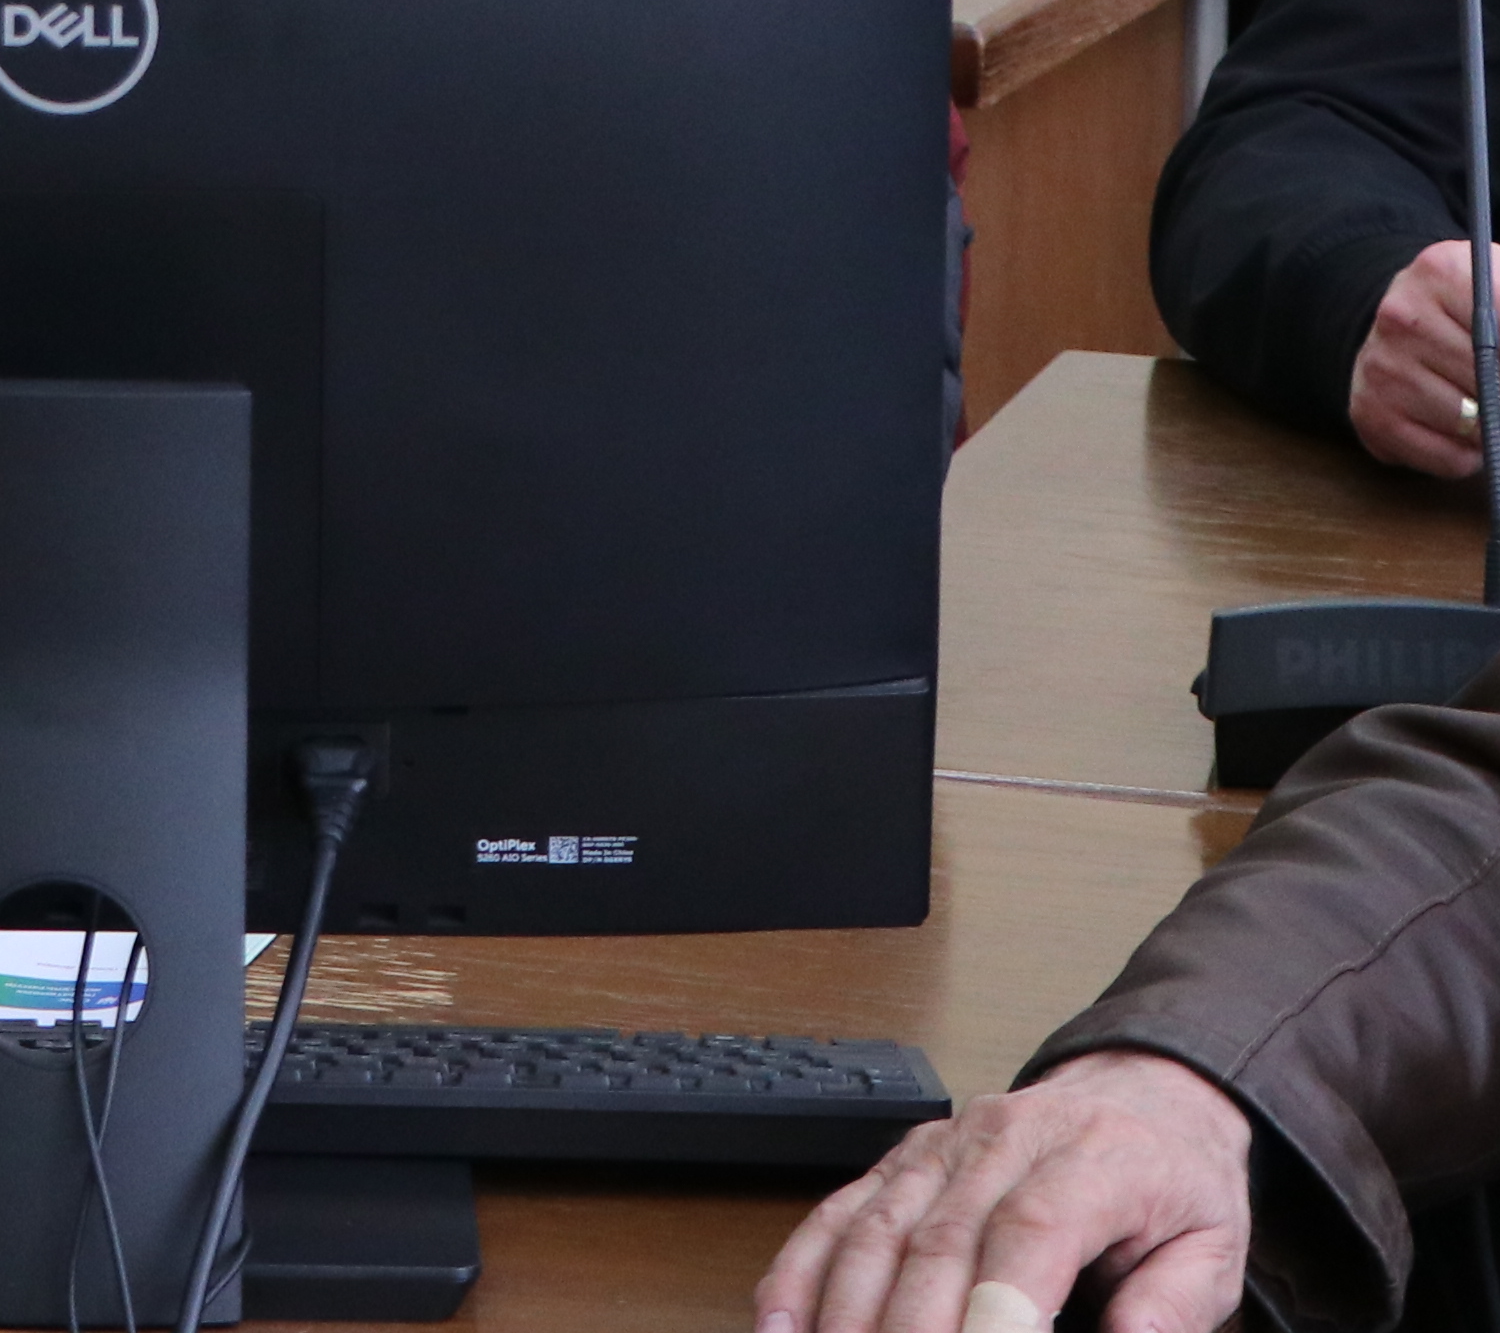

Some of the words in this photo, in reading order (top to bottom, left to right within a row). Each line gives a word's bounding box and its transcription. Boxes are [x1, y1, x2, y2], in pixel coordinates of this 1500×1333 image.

[3, 2, 139, 48] DELL
[1275, 637, 1498, 689] PHILIP
[477, 838, 537, 853] OptiPlex
[521, 853, 548, 862] Series
